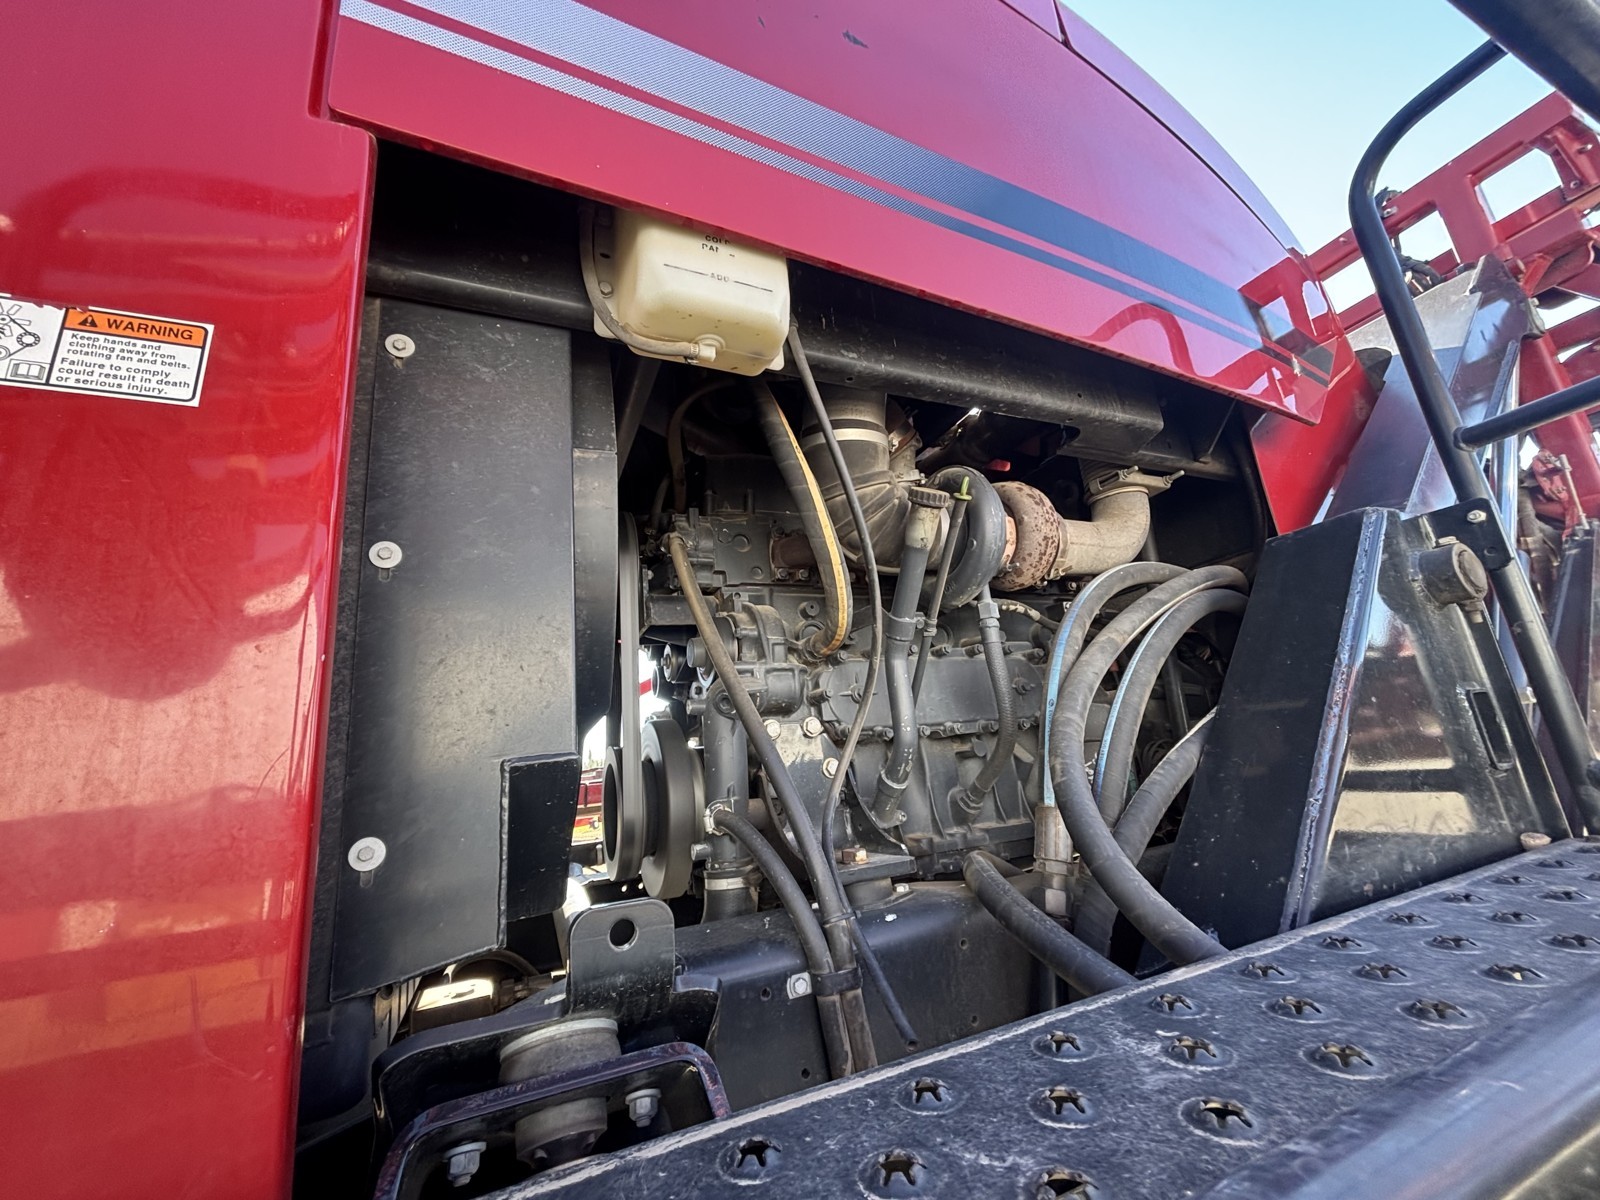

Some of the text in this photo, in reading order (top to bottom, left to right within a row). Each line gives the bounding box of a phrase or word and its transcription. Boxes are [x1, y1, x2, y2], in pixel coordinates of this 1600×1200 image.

[107, 318, 193, 340] WARNING
[71, 333, 100, 343] Keep
[103, 337, 137, 347] hands
[67, 349, 190, 369] rotating fan and belts.
[69, 341, 176, 360] clothing away from
[58, 367, 190, 388] could result in death
[60, 357, 105, 369] Failure
[126, 367, 171, 378] comply
[74, 378, 123, 388] serious
[128, 383, 168, 395] injury.
